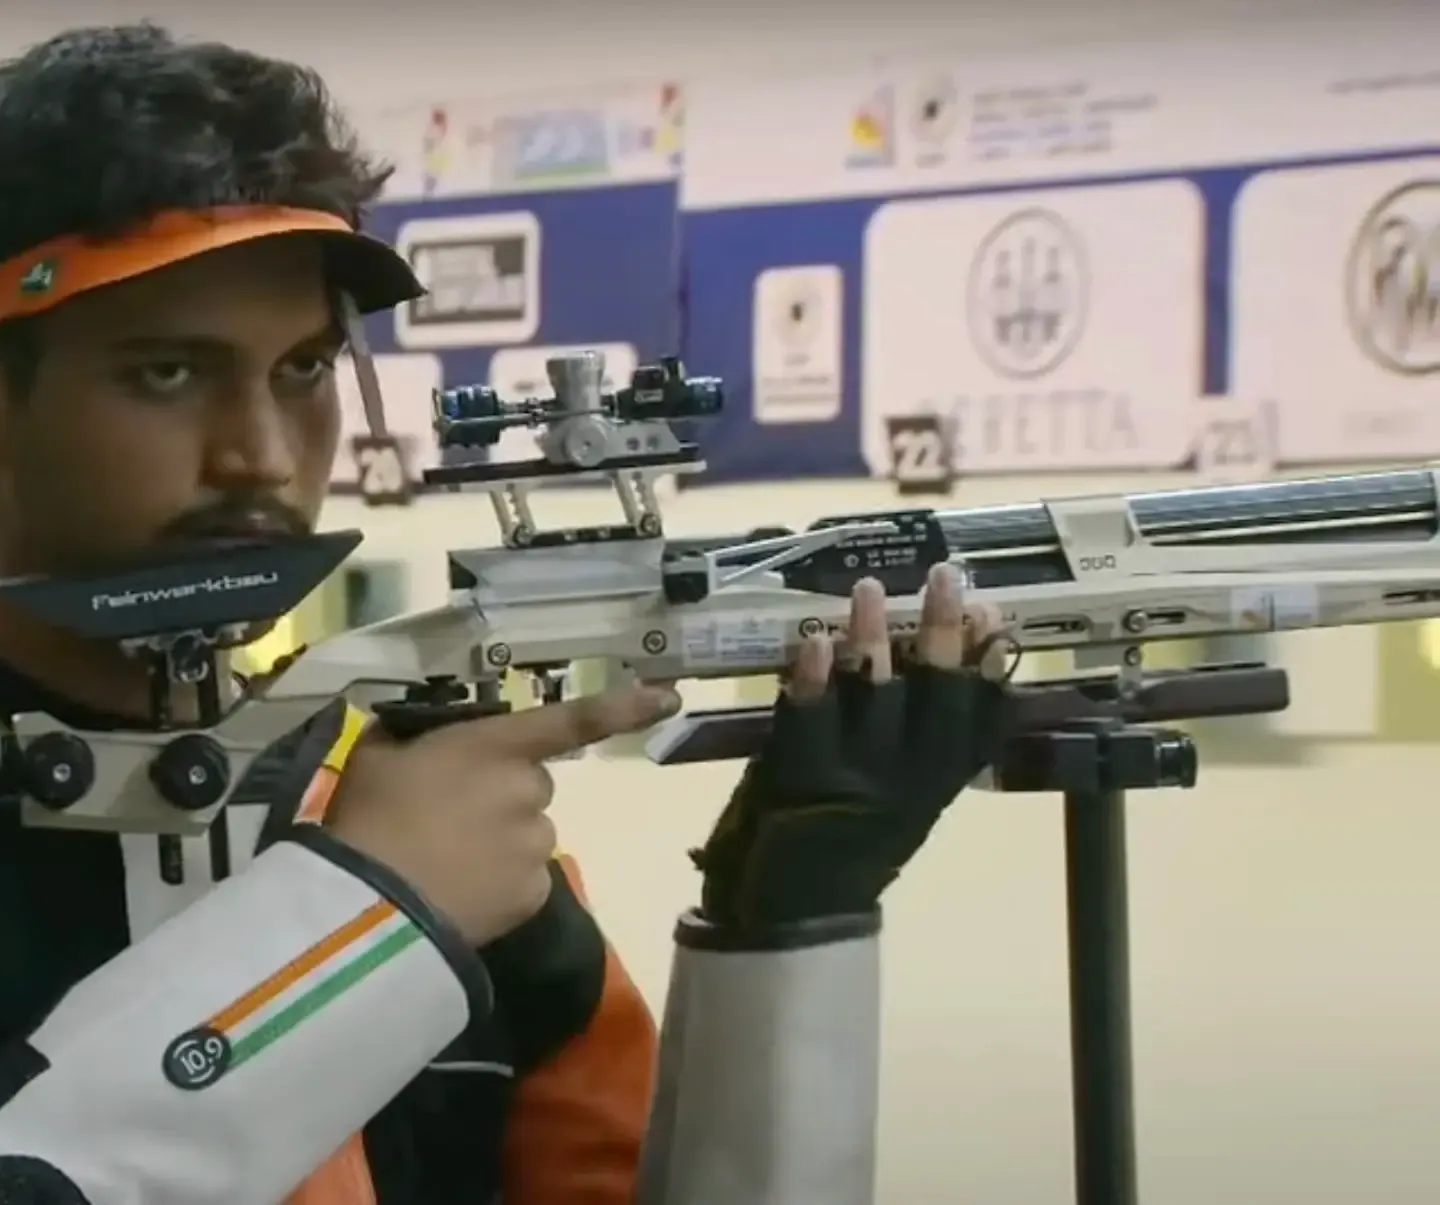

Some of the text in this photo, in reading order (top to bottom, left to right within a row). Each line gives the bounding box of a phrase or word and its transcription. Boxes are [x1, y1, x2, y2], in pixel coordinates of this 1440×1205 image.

[918, 389, 1140, 454] ERETTA
[892, 429, 946, 481] 22
[91, 571, 279, 611] Feinwerkbau
[180, 1035, 224, 1075] 10.9
